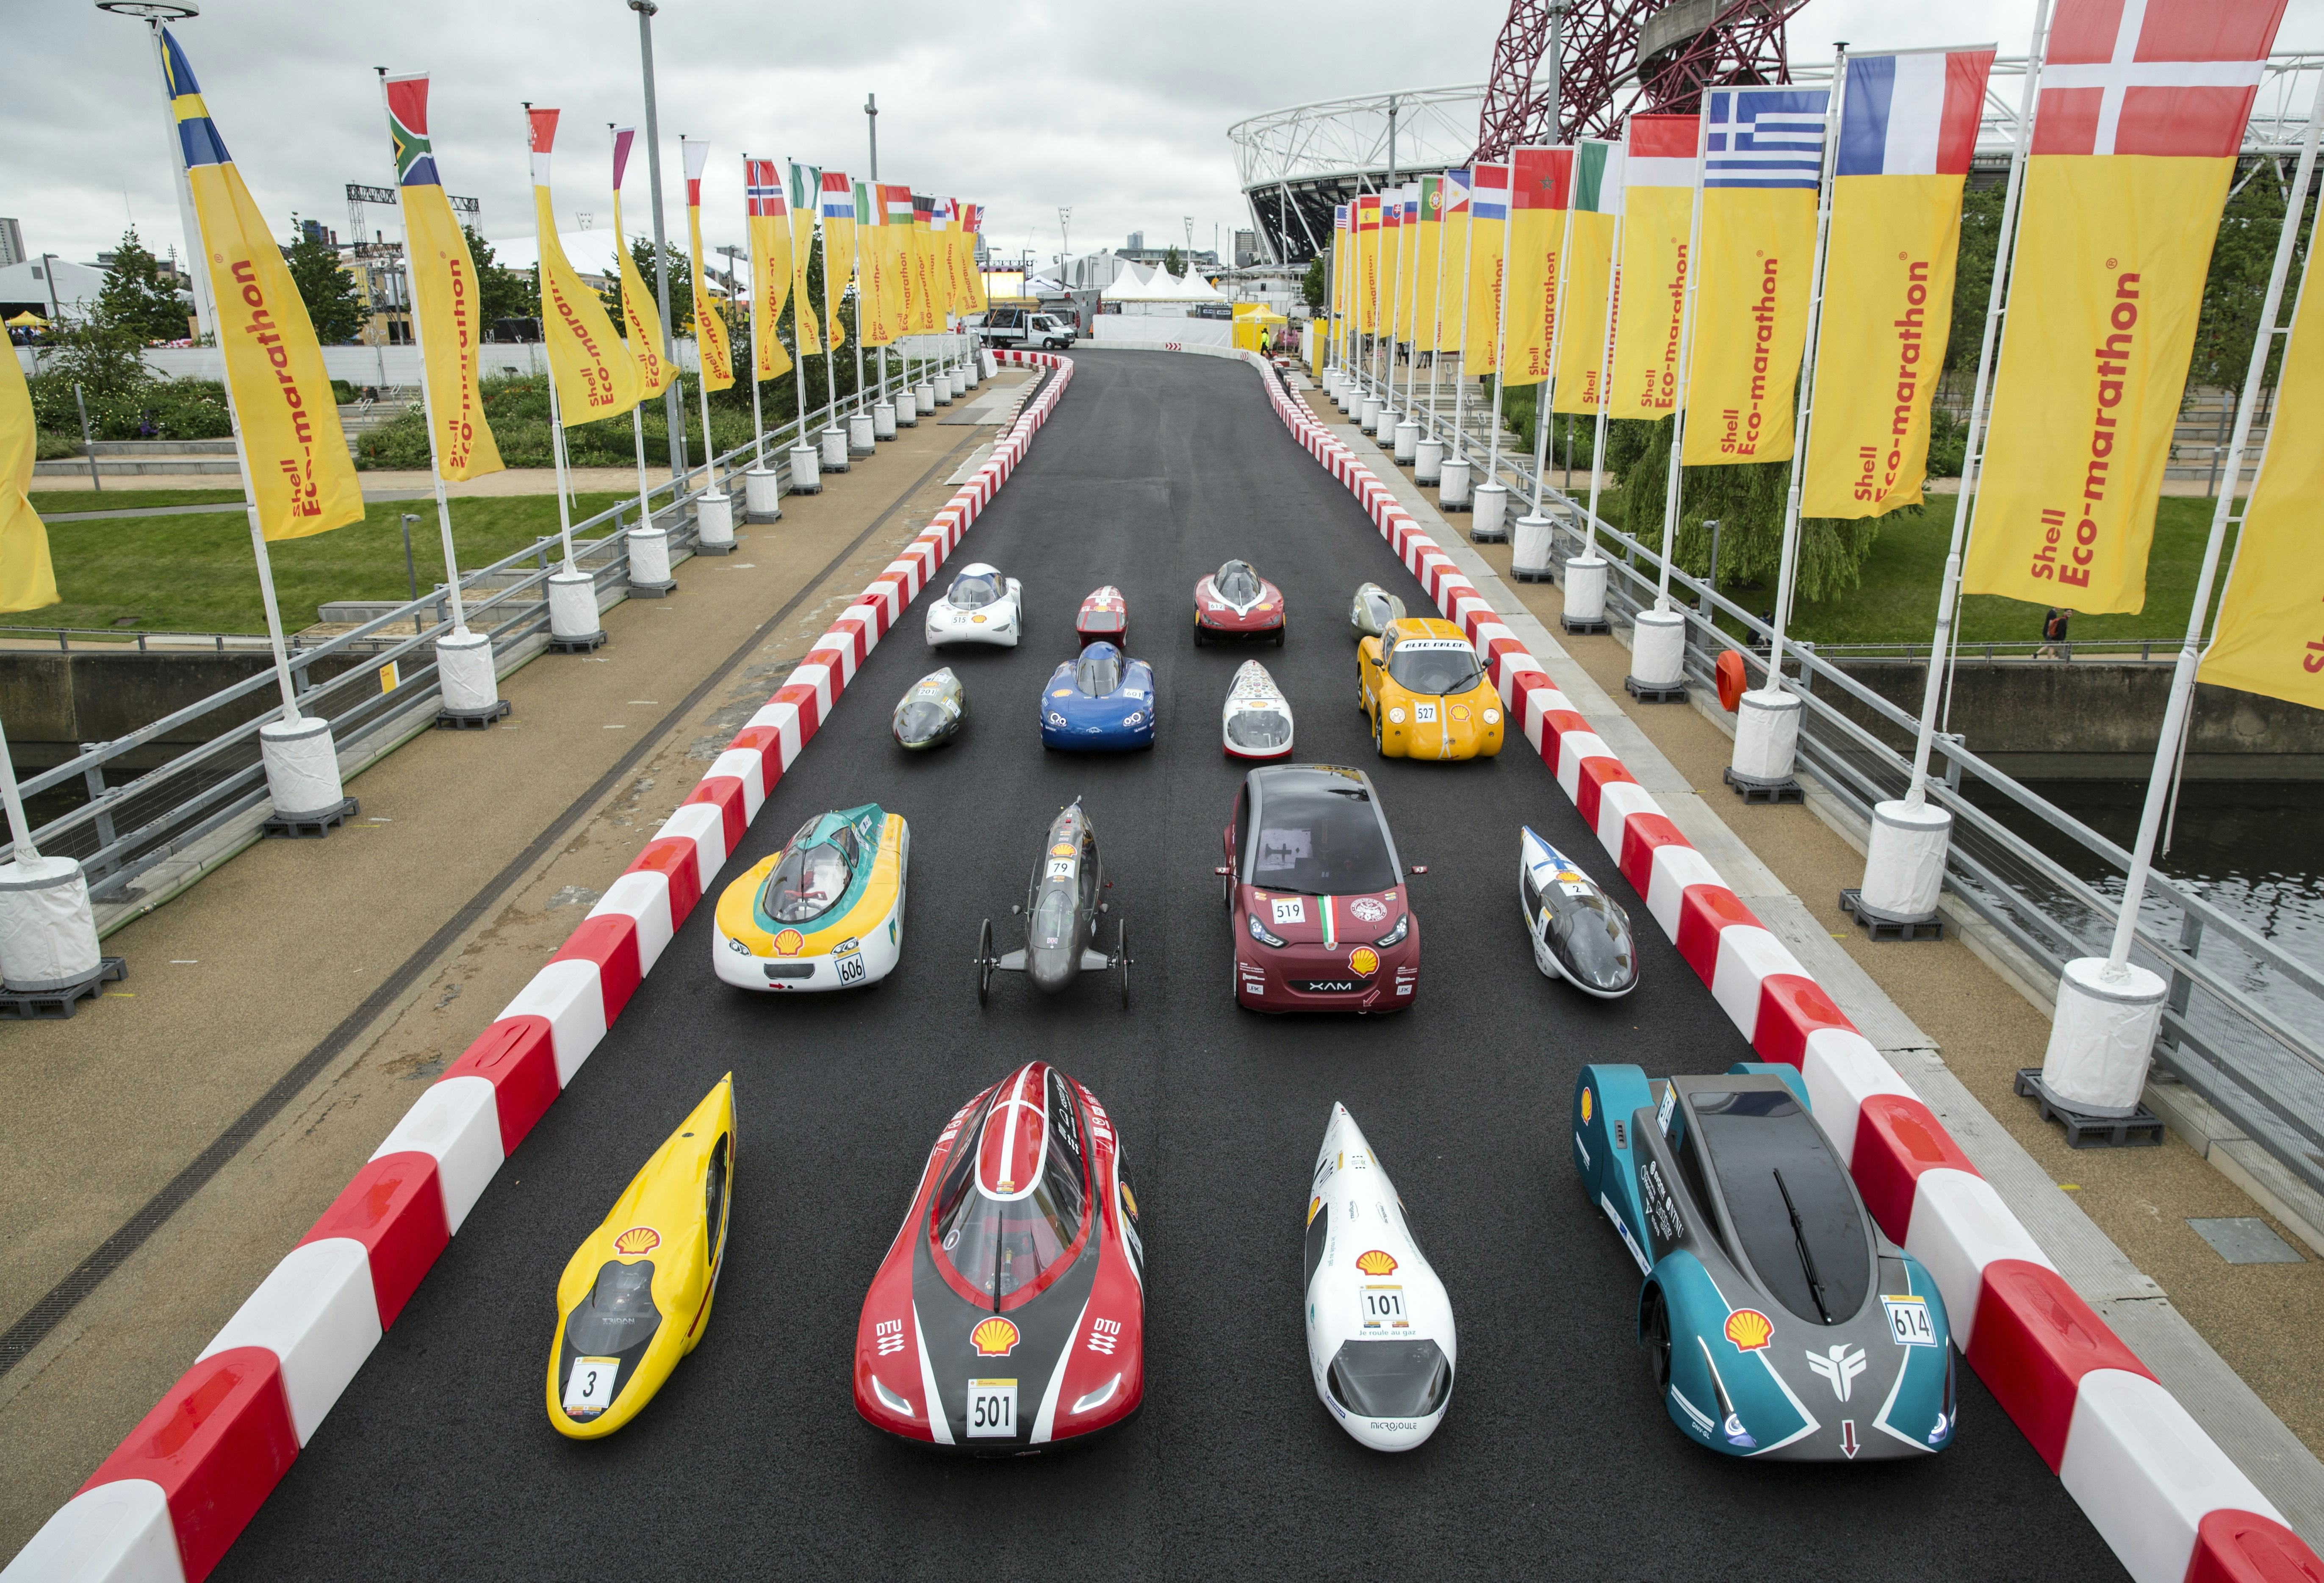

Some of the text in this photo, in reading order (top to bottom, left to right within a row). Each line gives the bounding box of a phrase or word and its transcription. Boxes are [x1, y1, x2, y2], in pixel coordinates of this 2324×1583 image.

[900, 252, 910, 331] Eco-marathon
[1655, 244, 1687, 408] Eco-marathon
[705, 352, 723, 379] Shell
[1529, 347, 1539, 376] Shell
[1737, 258, 1778, 455] Eco-marathon
[580, 368, 599, 407] Shell
[1583, 371, 1596, 403] Shell
[1641, 370, 1656, 407] Shell
[1722, 409, 1739, 453] Shell
[2058, 272, 2141, 588] Eco-marathon
[1854, 446, 1877, 501] Shell
[280, 459, 300, 518] Shell
[2031, 508, 2066, 580] Shell
[1418, 708, 1433, 719] 527
[1054, 863, 1068, 872] 79
[1277, 905, 1299, 917] 519
[1540, 919, 1543, 935] 2
[842, 959, 862, 981] 606
[1644, 1176, 1654, 1203] Horizon
[1669, 1203, 1684, 1238] NTNU
[1368, 1295, 1400, 1315] 101
[876, 1319, 902, 1336] DTU
[1094, 1317, 1121, 1335] DTU
[1895, 1309, 1930, 1337] 614
[583, 1371, 597, 1397] 3
[975, 1396, 1009, 1427] 501
[1328, 1397, 1345, 1417] MICHELIN
